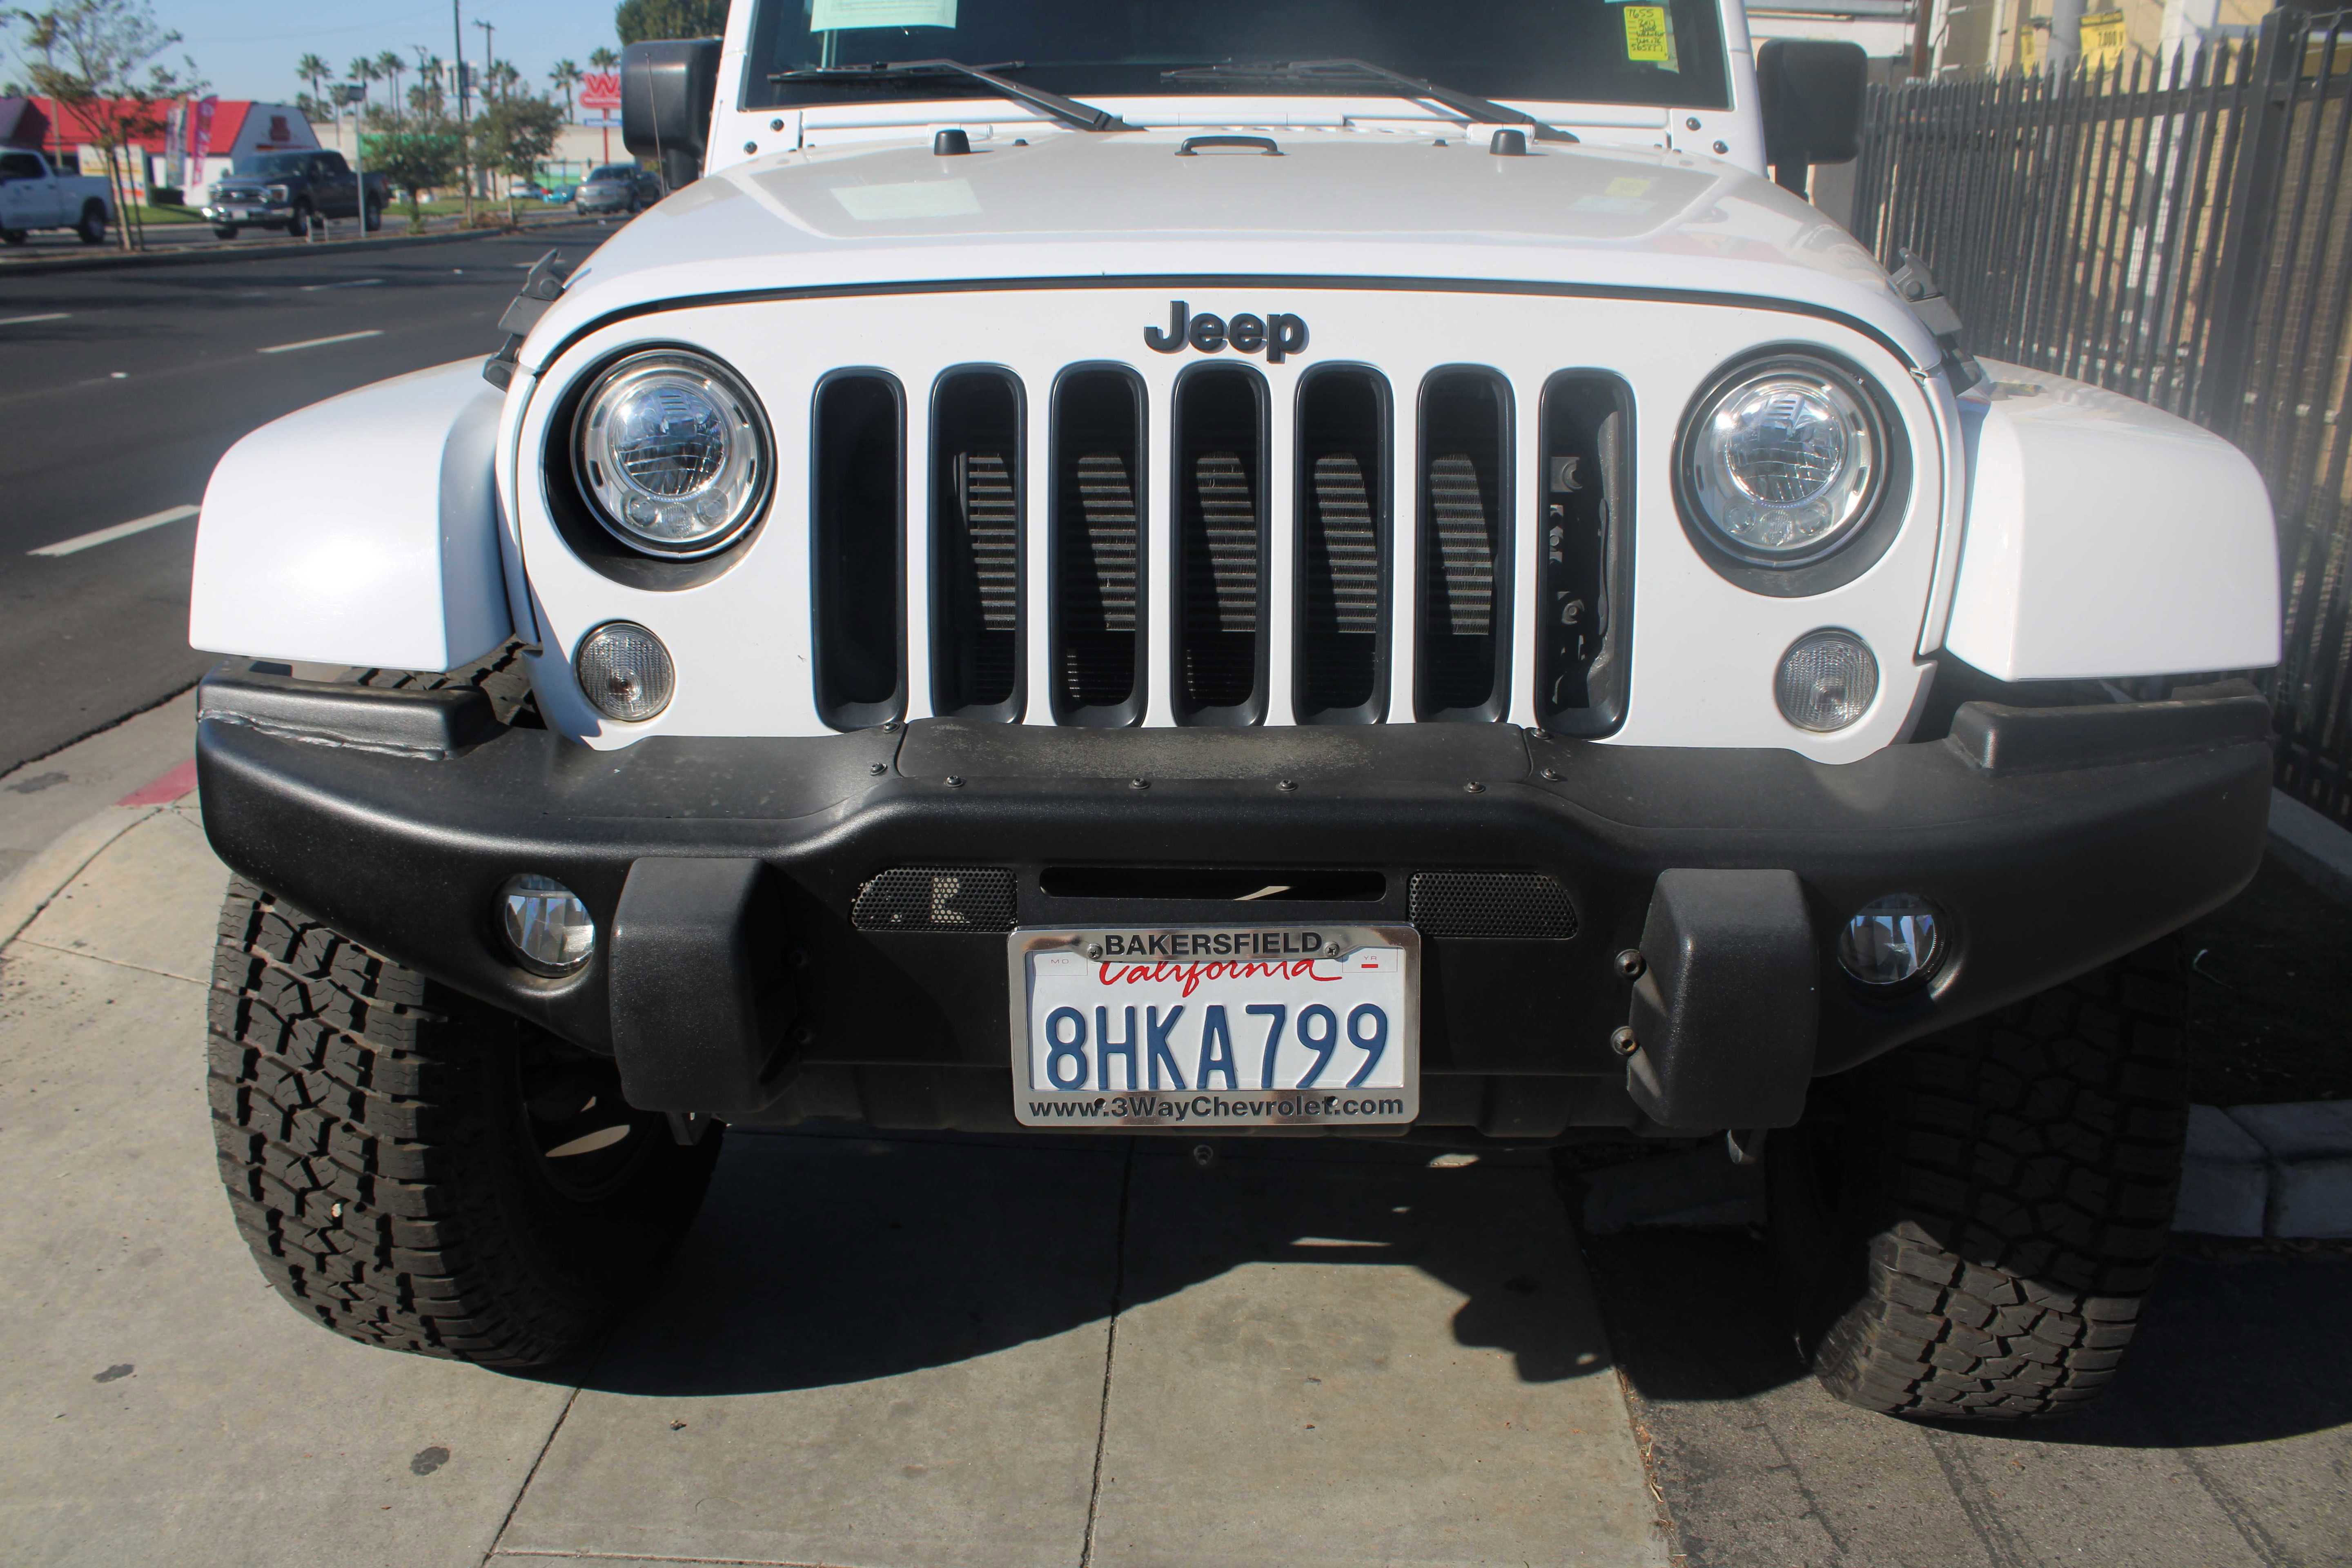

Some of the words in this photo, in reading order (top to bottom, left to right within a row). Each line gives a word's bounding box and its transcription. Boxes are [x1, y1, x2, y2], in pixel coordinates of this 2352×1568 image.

[1144, 301, 1307, 362] Jeep
[1105, 932, 1323, 956] BAKERSFIELD
[1045, 1003, 1388, 1089] 8HKA799
[1029, 1095, 1404, 1121] www.3WayChevrolet.com
